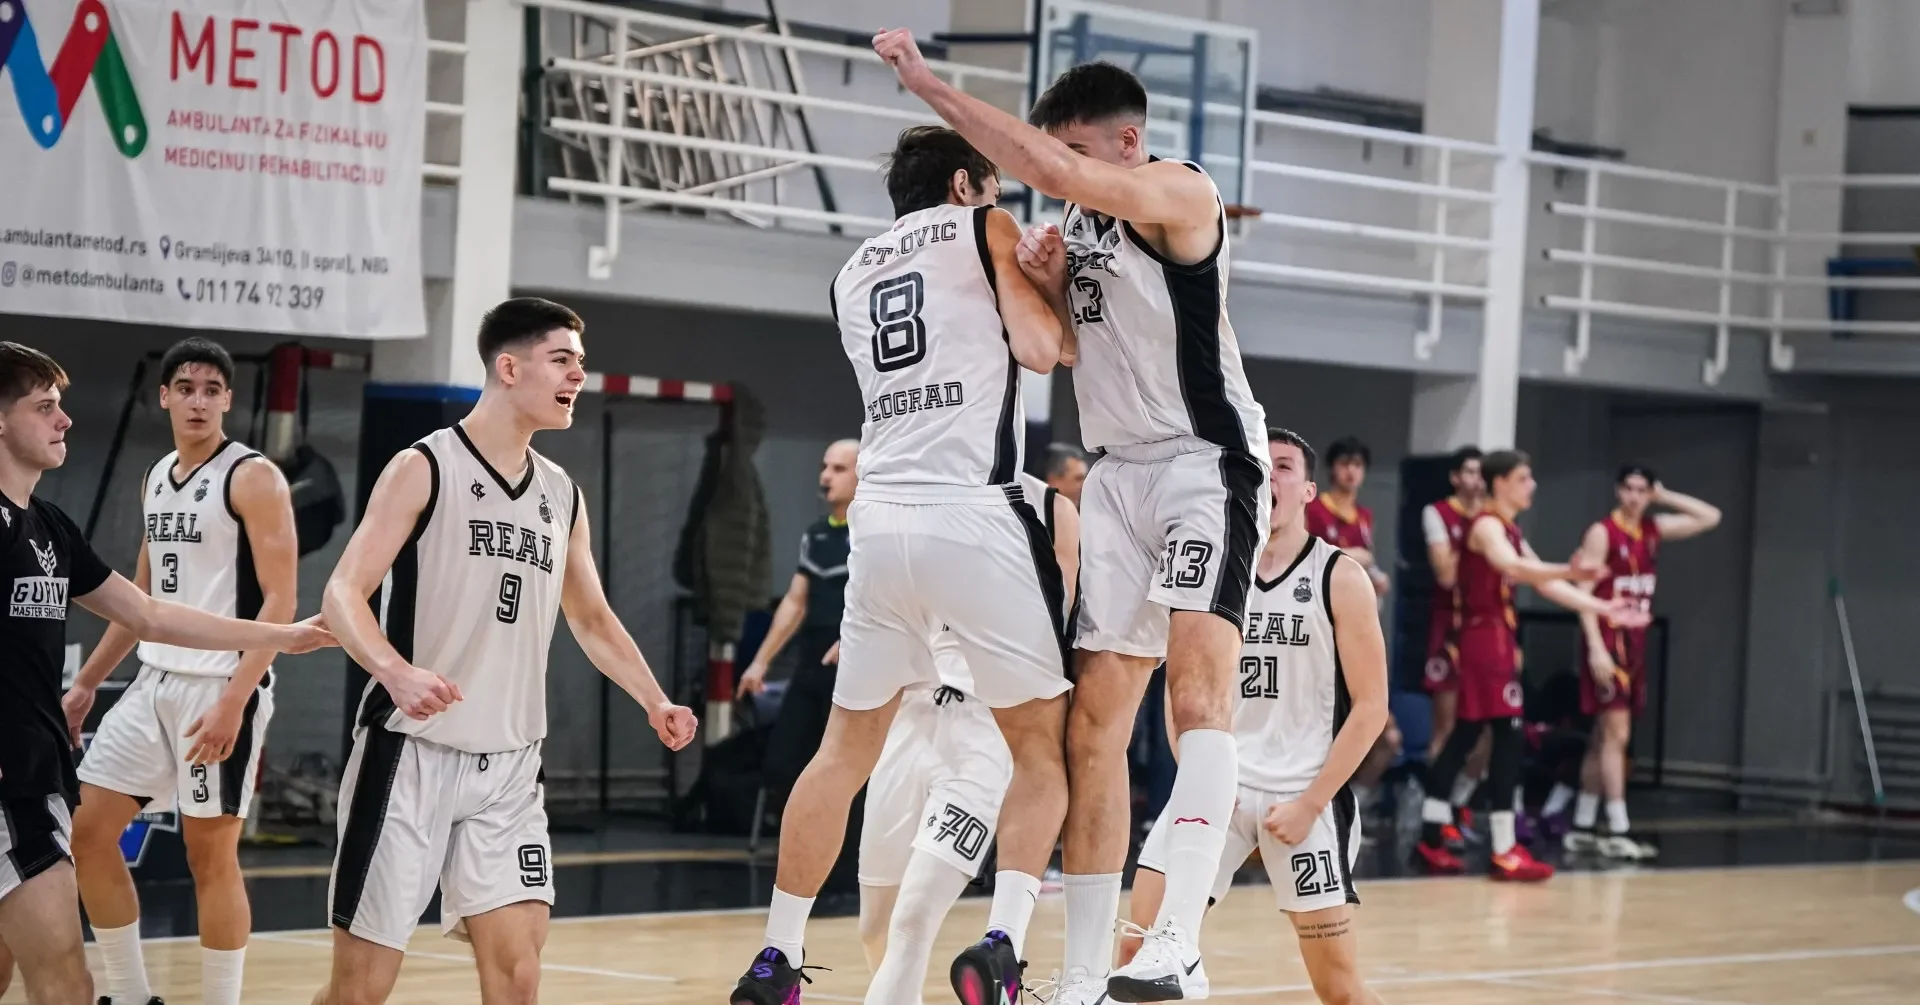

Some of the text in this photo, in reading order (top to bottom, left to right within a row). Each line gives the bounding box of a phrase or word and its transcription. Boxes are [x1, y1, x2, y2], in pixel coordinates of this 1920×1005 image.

[169, 10, 386, 104] METOD
[166, 109, 388, 149] AMBULANTA ZA FZIKALNU
[164, 147, 245, 172] MEDICINU
[258, 154, 385, 186] REHABILITACIU
[847, 220, 957, 271] ETOVIĆ
[196, 277, 228, 304] 011
[234, 279, 261, 305] 74
[288, 284, 324, 311] 339
[869, 271, 927, 373] 8
[868, 381, 964, 423] EOGRAD
[147, 512, 202, 543] REAL
[468, 519, 554, 575] REAL
[161, 552, 178, 593] 3
[1160, 540, 1214, 589] 13
[12, 605, 43, 618] MASTER
[496, 572, 523, 624] 9
[1244, 612, 1310, 646] EAL
[1239, 656, 1280, 700] 21
[190, 763, 210, 803] 3
[933, 802, 989, 861] 70
[517, 844, 548, 888] 9
[1291, 850, 1340, 898] 21
